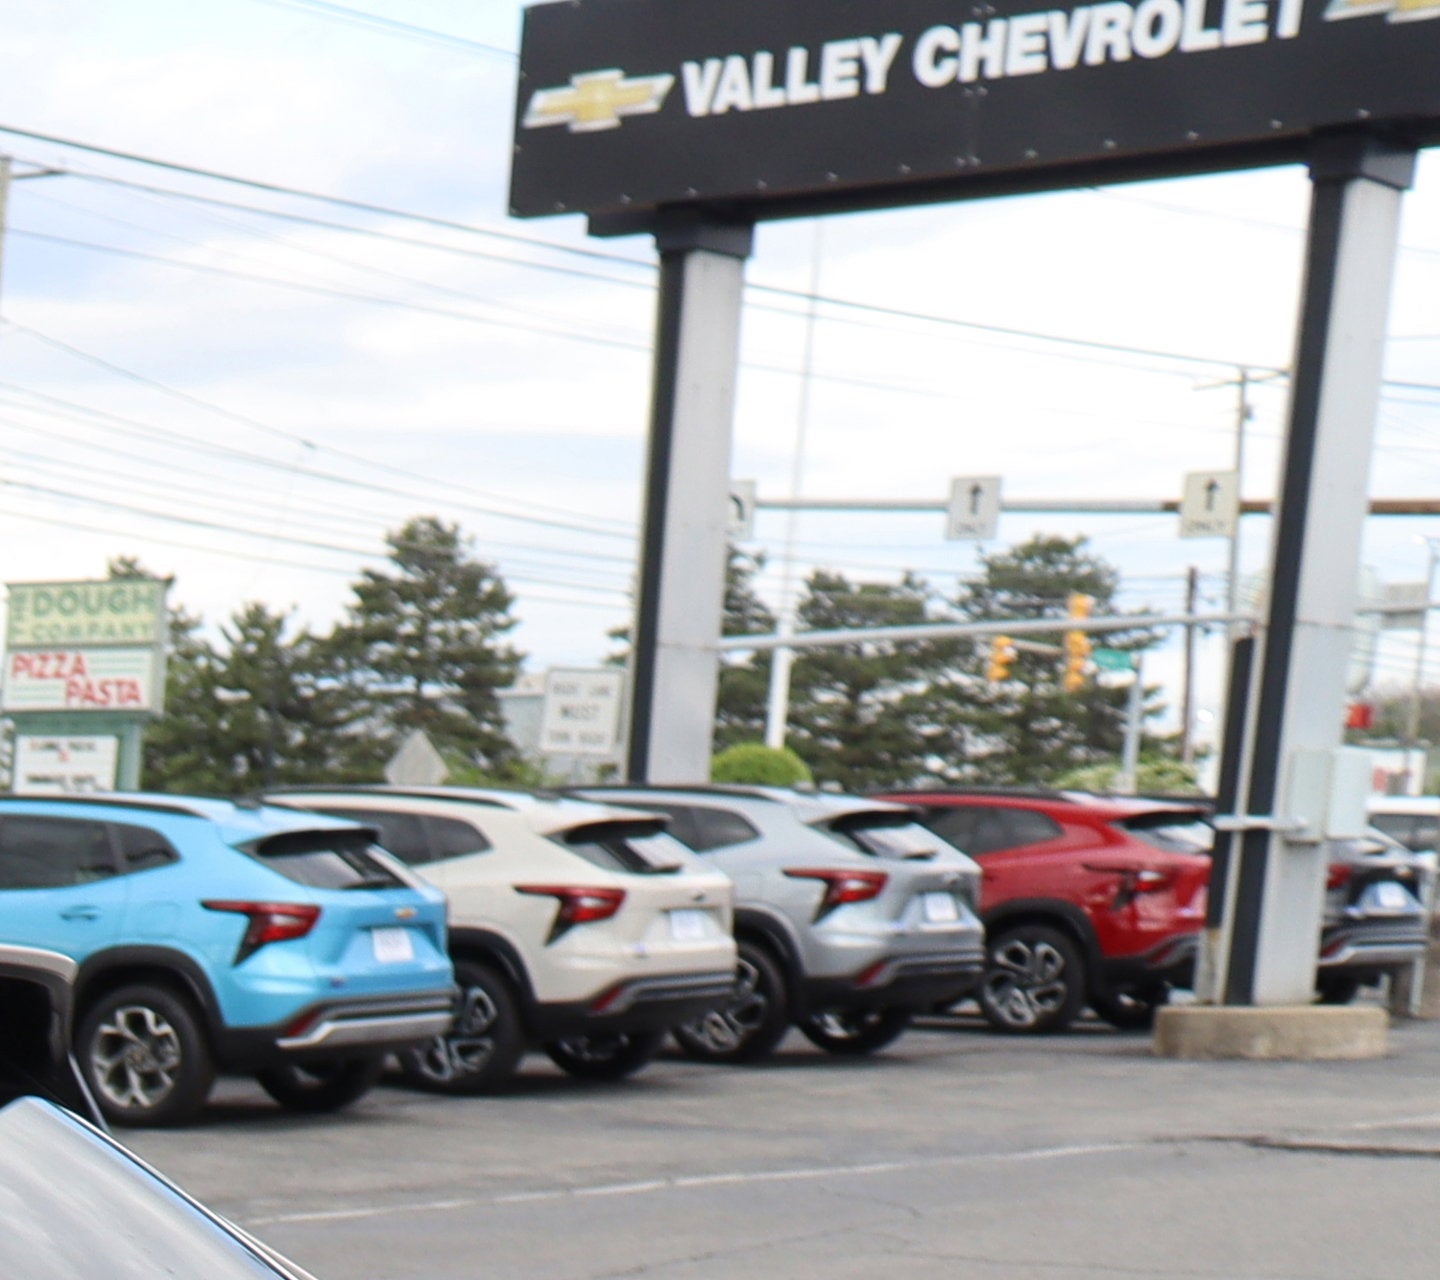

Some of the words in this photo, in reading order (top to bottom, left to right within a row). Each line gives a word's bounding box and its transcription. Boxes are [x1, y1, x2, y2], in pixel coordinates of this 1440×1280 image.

[681, 32, 903, 117] VALLEY
[33, 588, 155, 617] DOUGH
[11, 653, 88, 680] PIZZA
[66, 678, 142, 706] PASTA
